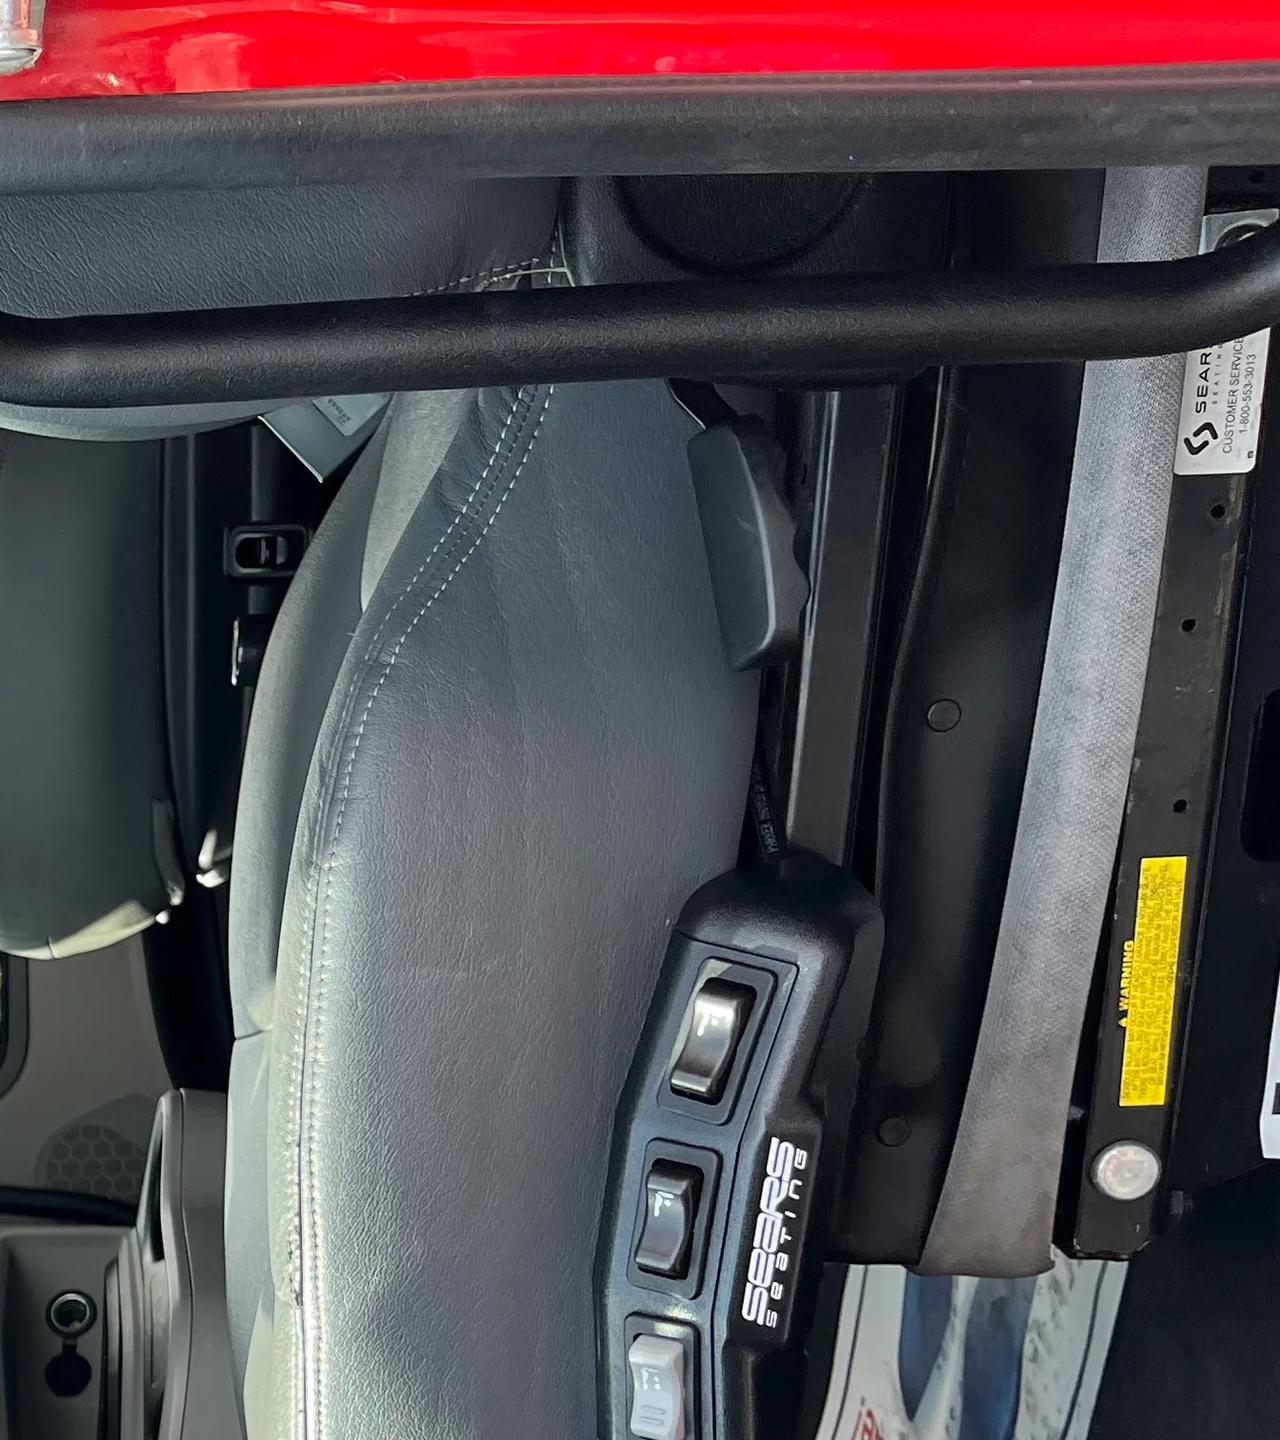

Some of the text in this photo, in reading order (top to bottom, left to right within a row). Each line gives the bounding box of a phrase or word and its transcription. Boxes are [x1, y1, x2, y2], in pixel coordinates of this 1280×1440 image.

[1195, 344, 1213, 414] SEAR
[1222, 338, 1244, 453] CUSTOMER SERVICE
[1239, 353, 1255, 434] 1-800-553-3013
[1119, 940, 1134, 1011] WARNING
